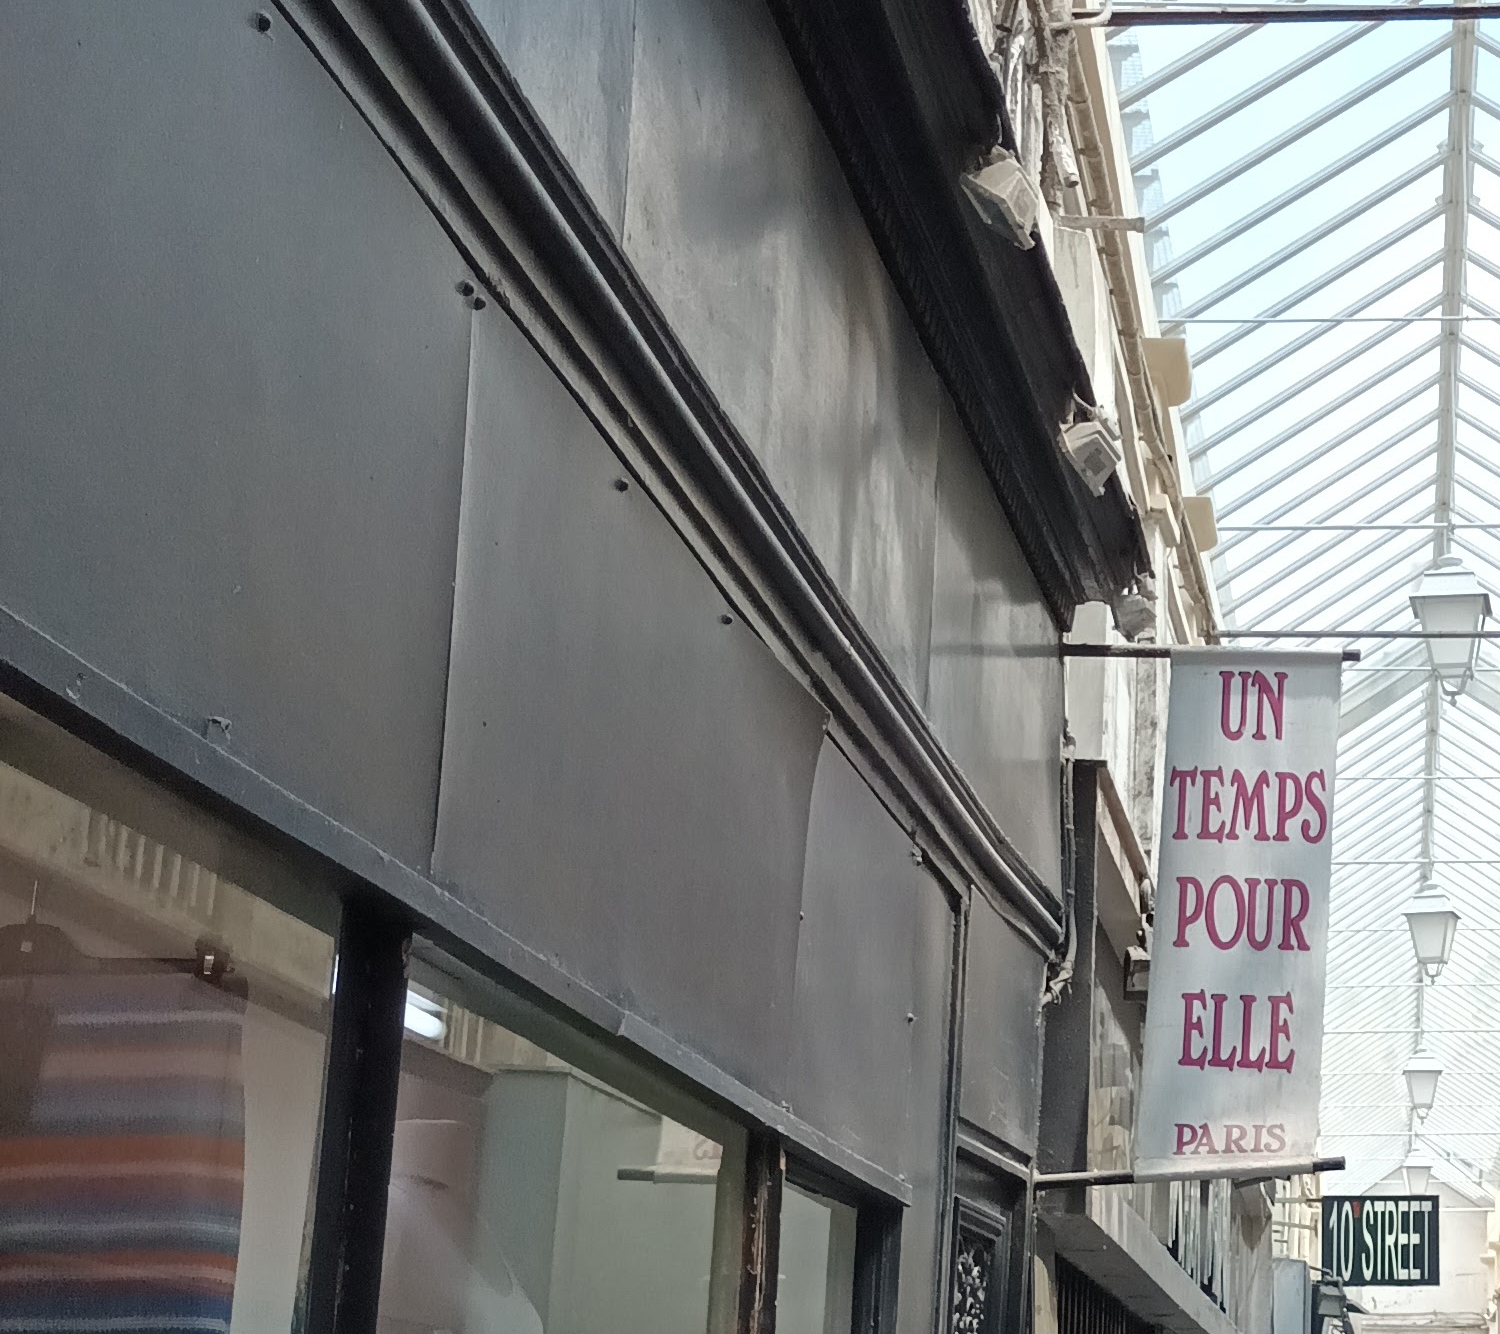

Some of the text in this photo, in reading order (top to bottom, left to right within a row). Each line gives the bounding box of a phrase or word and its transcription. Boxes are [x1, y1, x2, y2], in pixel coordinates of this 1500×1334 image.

[1218, 670, 1288, 741] UN
[1169, 766, 1327, 844] TEMPS
[1172, 874, 1311, 951] POUR
[1178, 989, 1296, 1073] ELLE
[1173, 1122, 1287, 1156] PARIS
[1361, 1199, 1433, 1281] STREET
